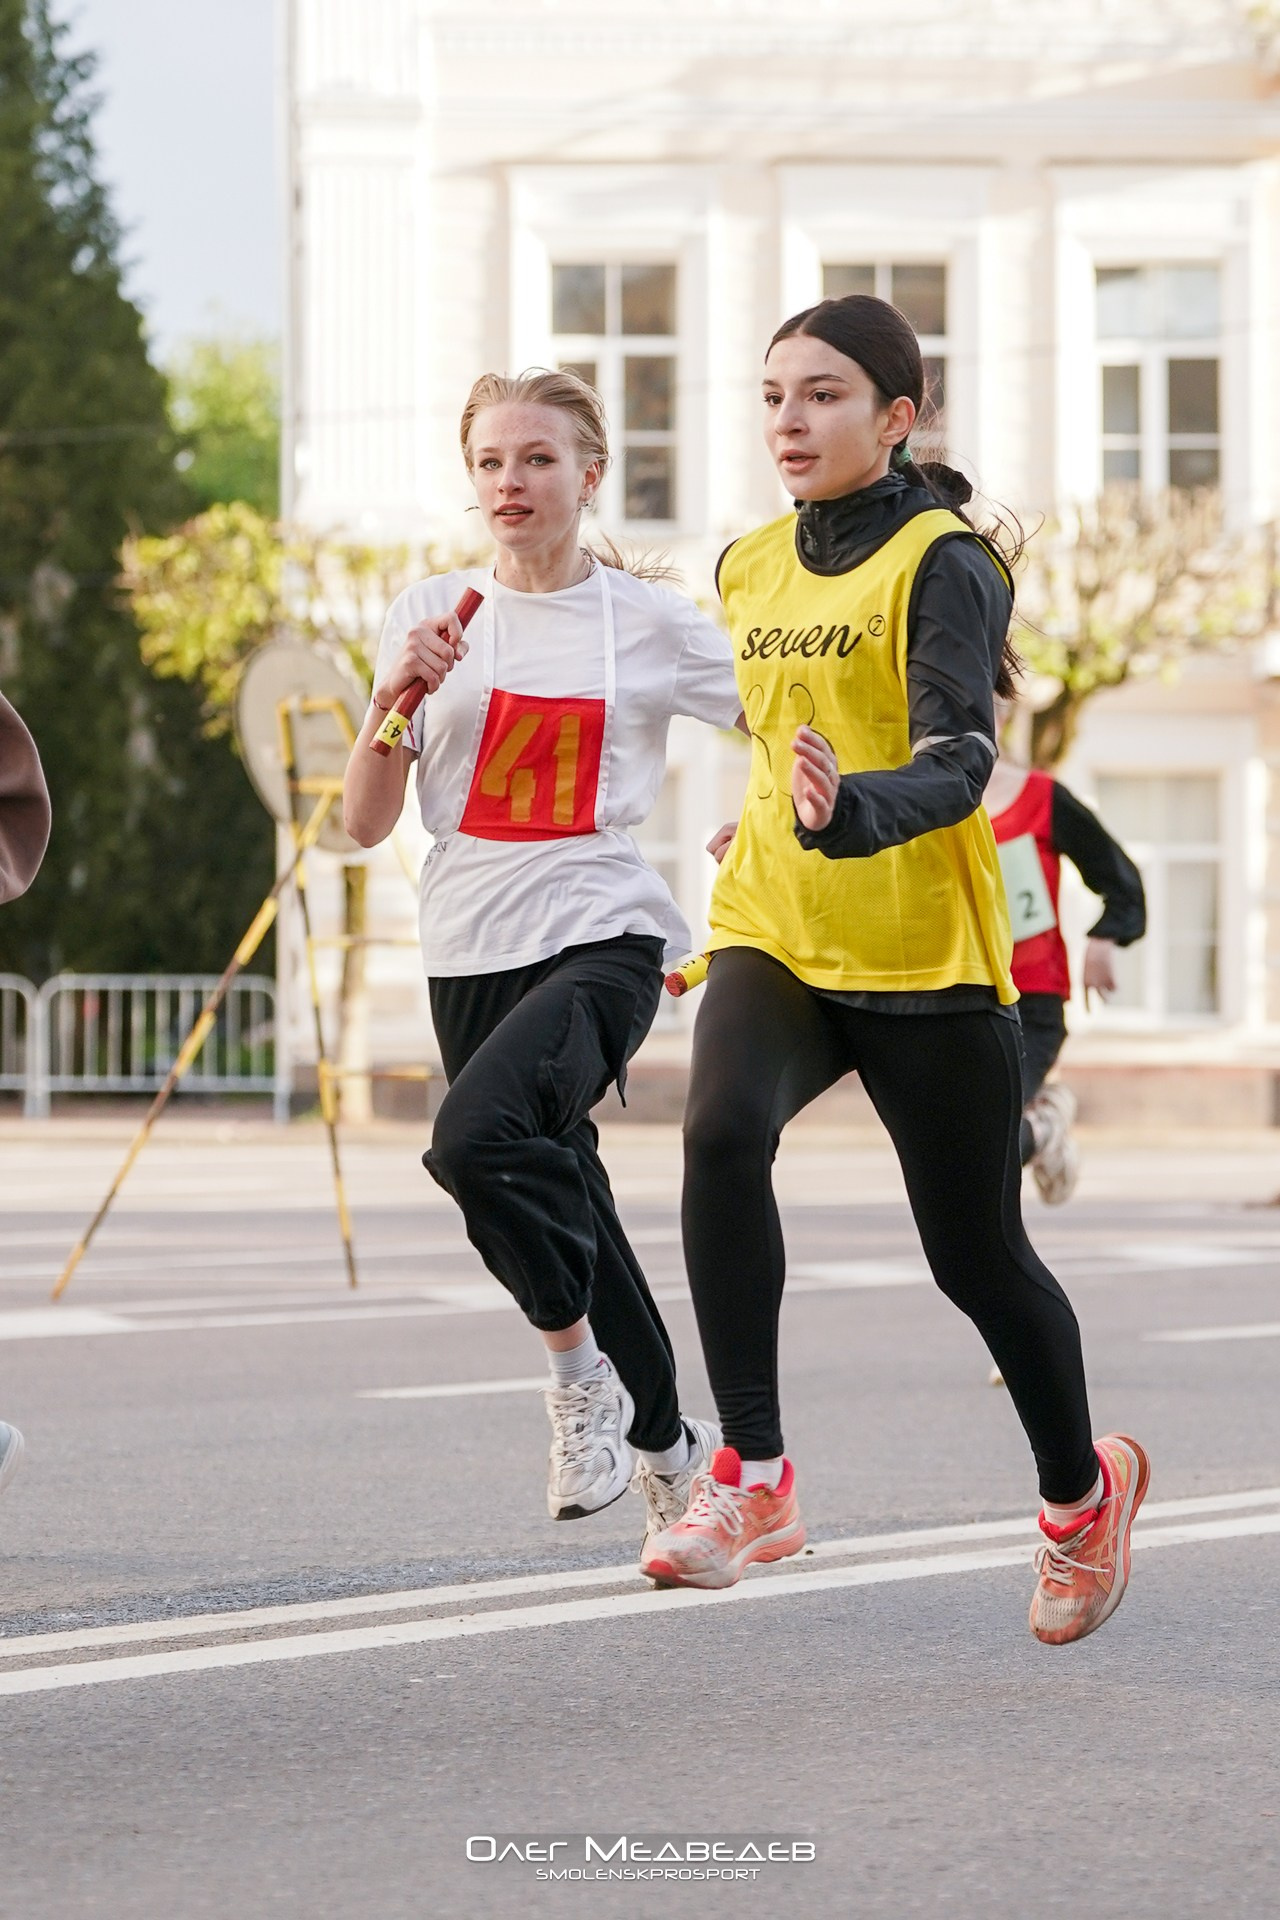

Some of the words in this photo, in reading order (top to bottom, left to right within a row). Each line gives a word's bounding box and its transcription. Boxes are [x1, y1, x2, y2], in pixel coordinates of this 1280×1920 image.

[741, 624, 863, 661] seven
[382, 719, 402, 739] 41
[480, 713, 581, 826] 41
[1017, 889, 1039, 920] 2
